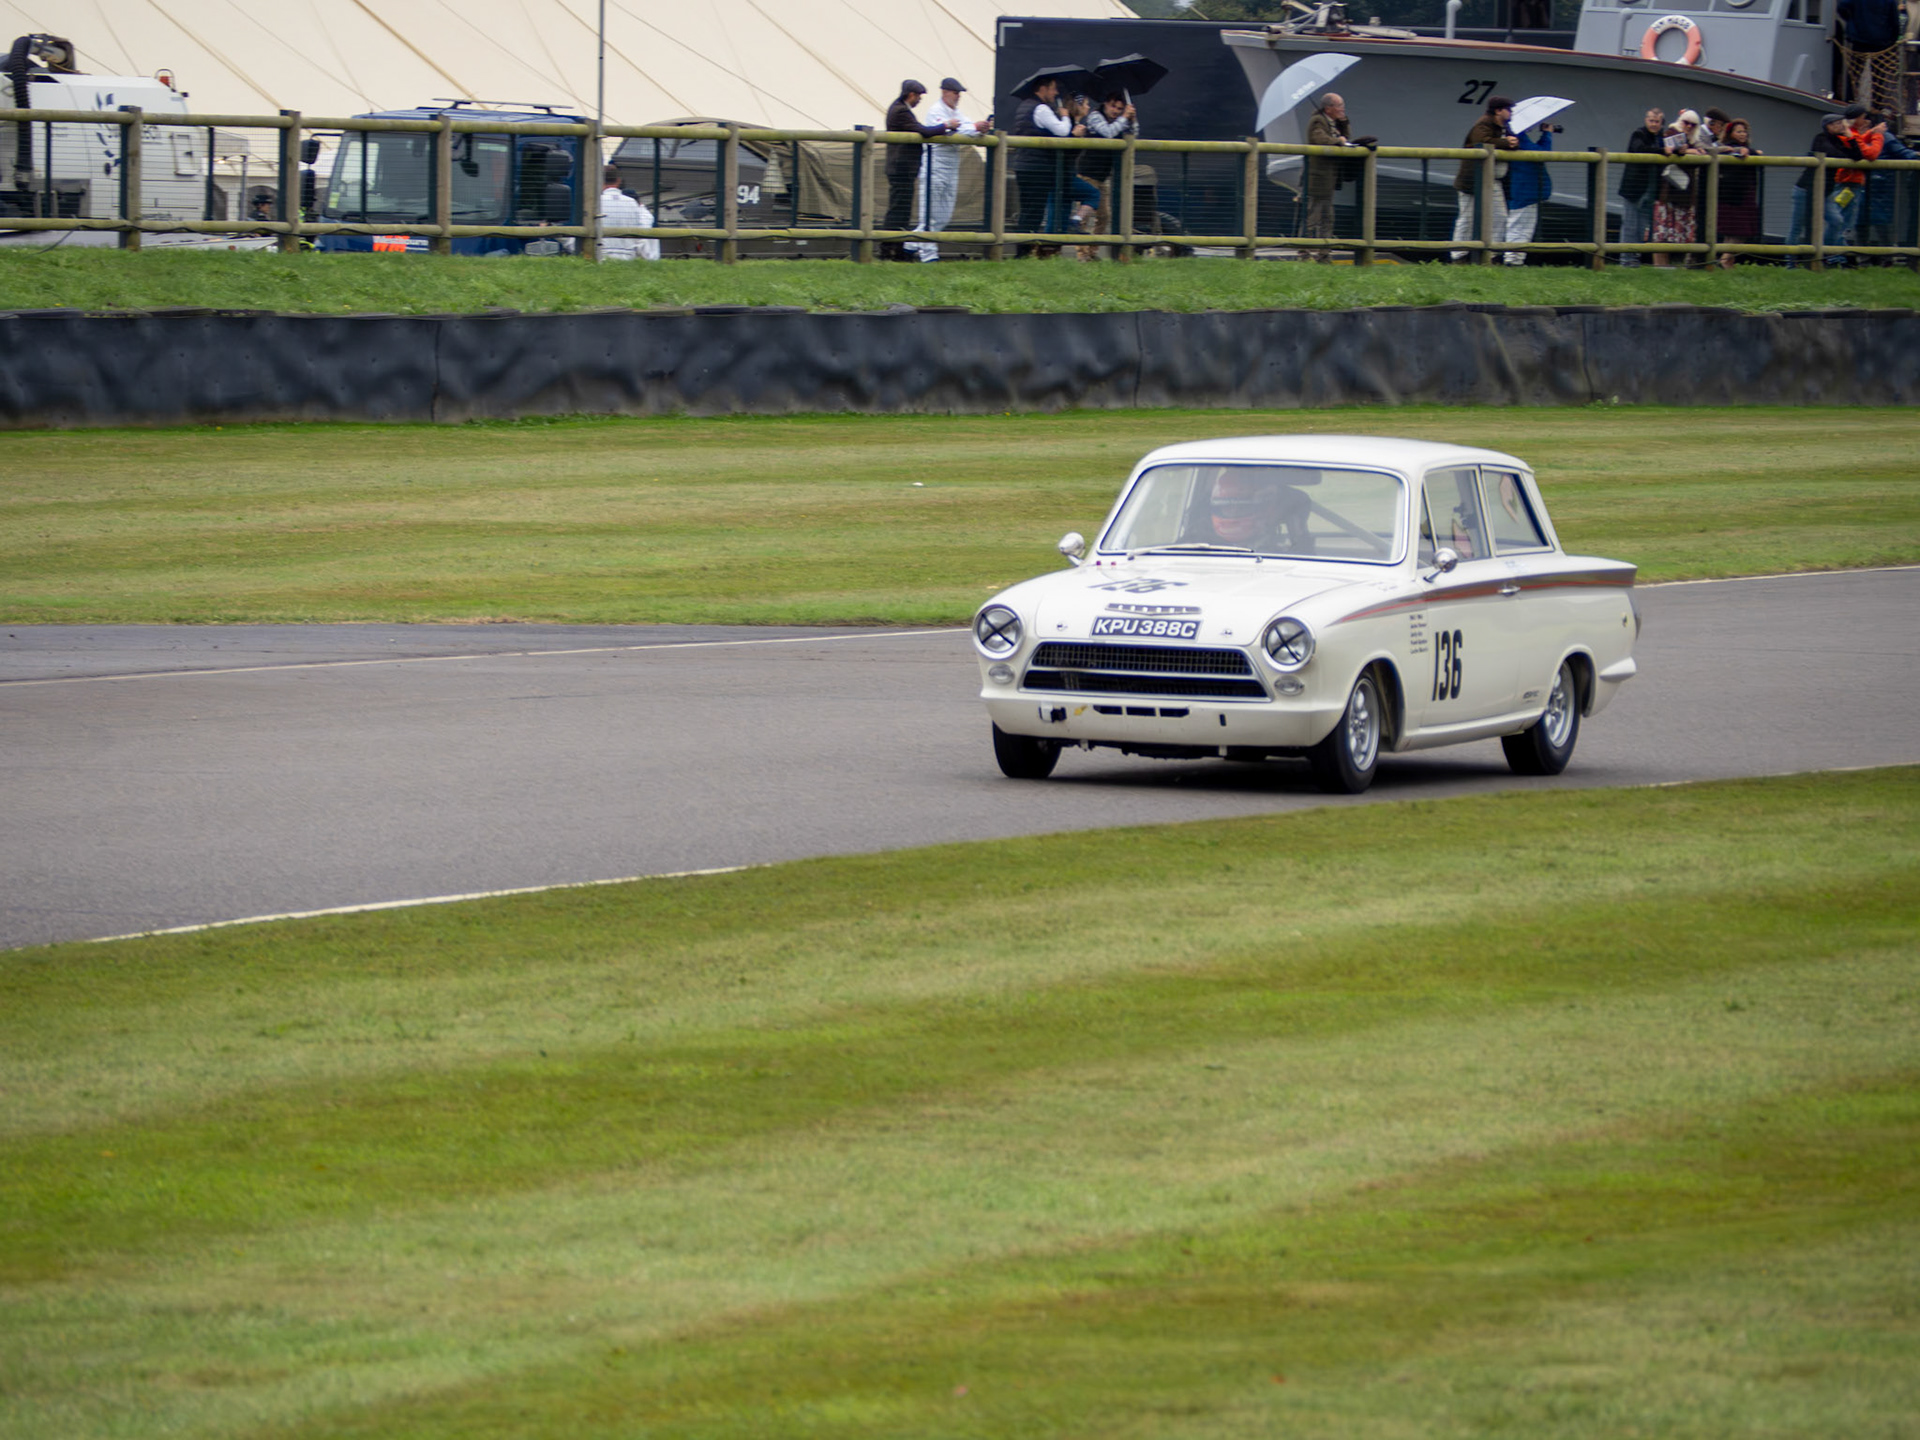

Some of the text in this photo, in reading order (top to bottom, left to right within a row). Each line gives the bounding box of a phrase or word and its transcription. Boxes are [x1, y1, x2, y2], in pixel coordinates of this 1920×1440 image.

[1457, 79, 1498, 105] 27
[736, 184, 760, 204] 94
[1087, 576, 1189, 593] 136
[1094, 619, 1197, 637] KPU388C
[1432, 629, 1463, 702] 136
